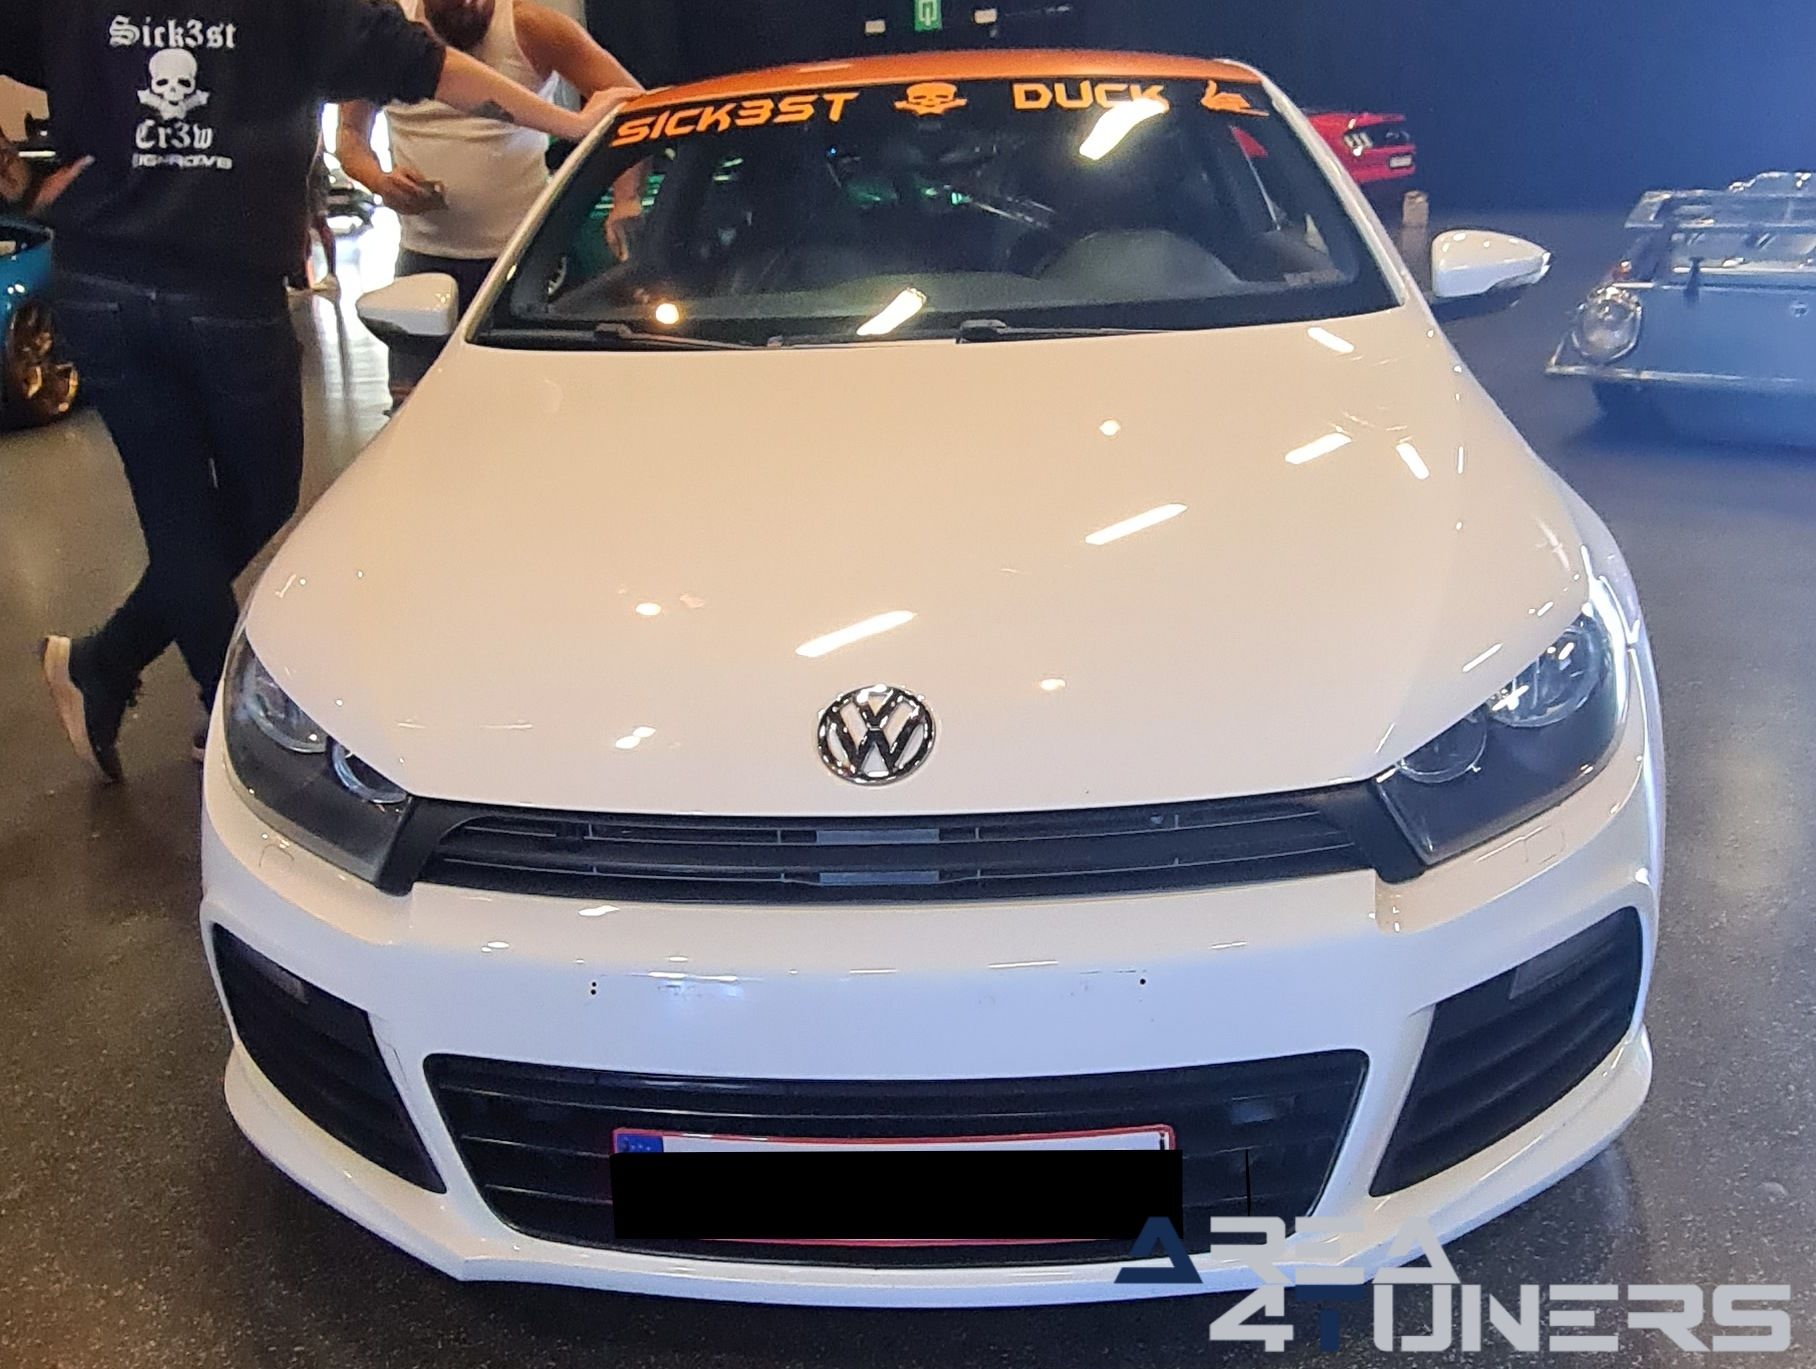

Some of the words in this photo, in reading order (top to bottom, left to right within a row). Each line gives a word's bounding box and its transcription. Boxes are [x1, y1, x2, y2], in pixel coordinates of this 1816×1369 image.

[109, 15, 237, 49] Sick3st
[610, 91, 860, 148] SICK3ST
[1012, 80, 1170, 115] DUCK
[135, 119, 214, 149] Cr3w
